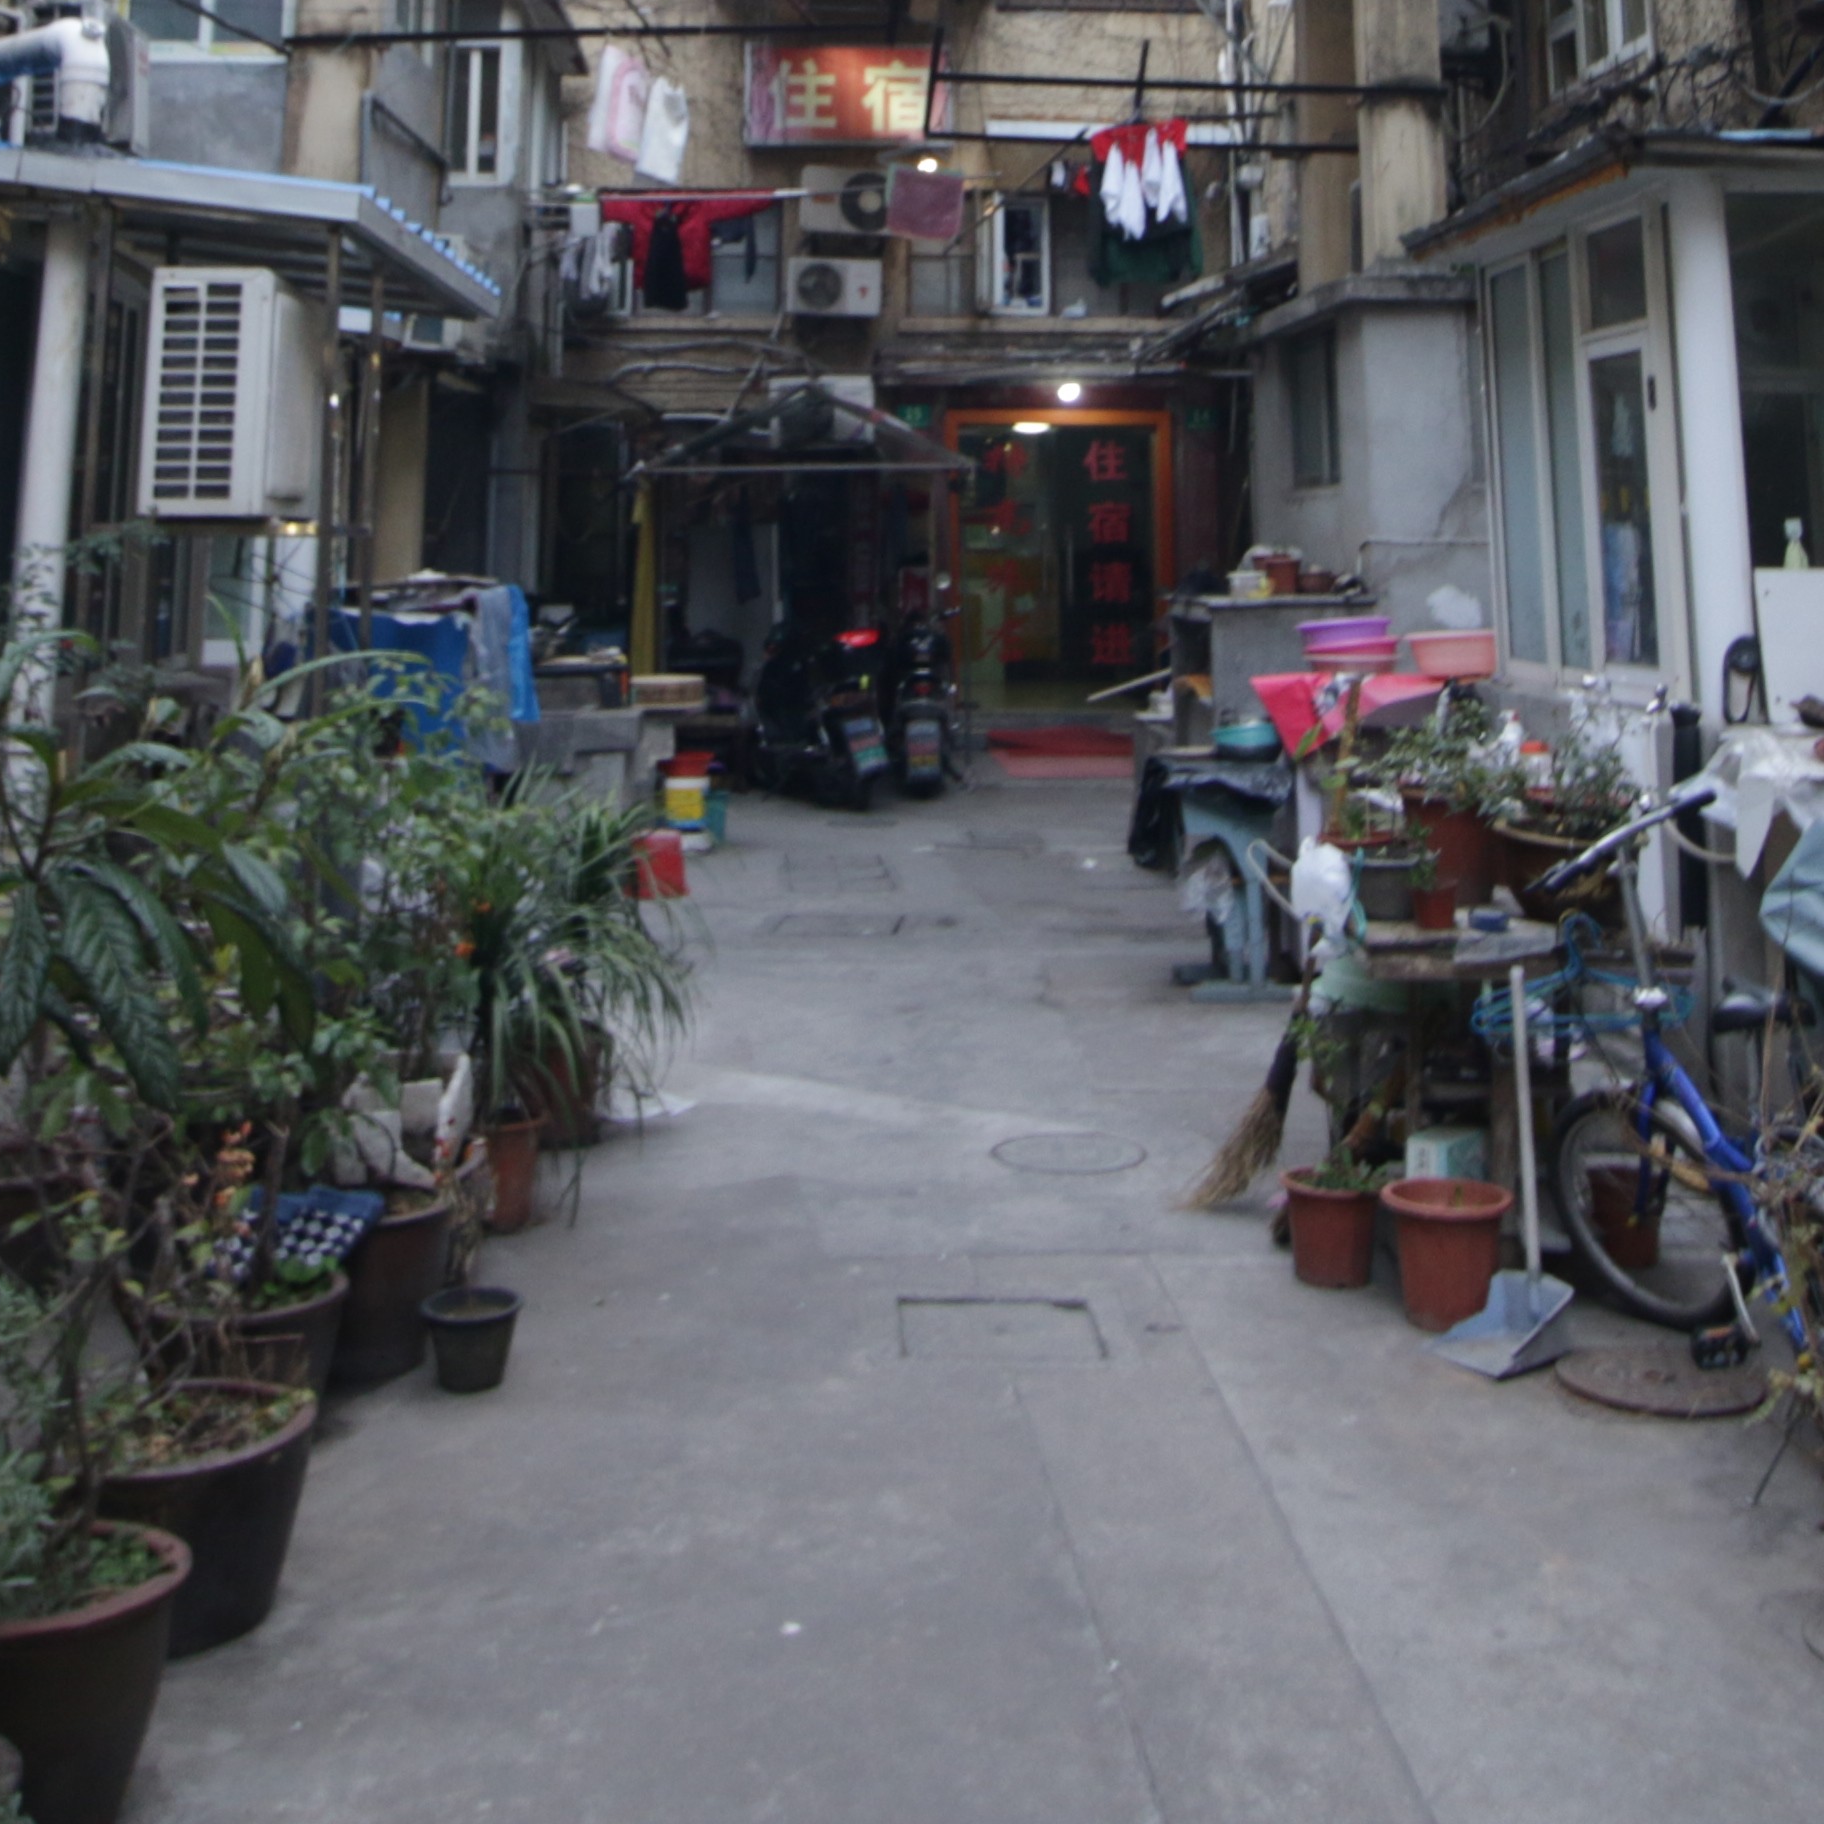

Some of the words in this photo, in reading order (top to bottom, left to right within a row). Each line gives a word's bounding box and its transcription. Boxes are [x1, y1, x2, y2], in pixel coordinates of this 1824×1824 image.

[768, 58, 932, 132] 住宿
[1082, 439, 1133, 664] 住宿请进
